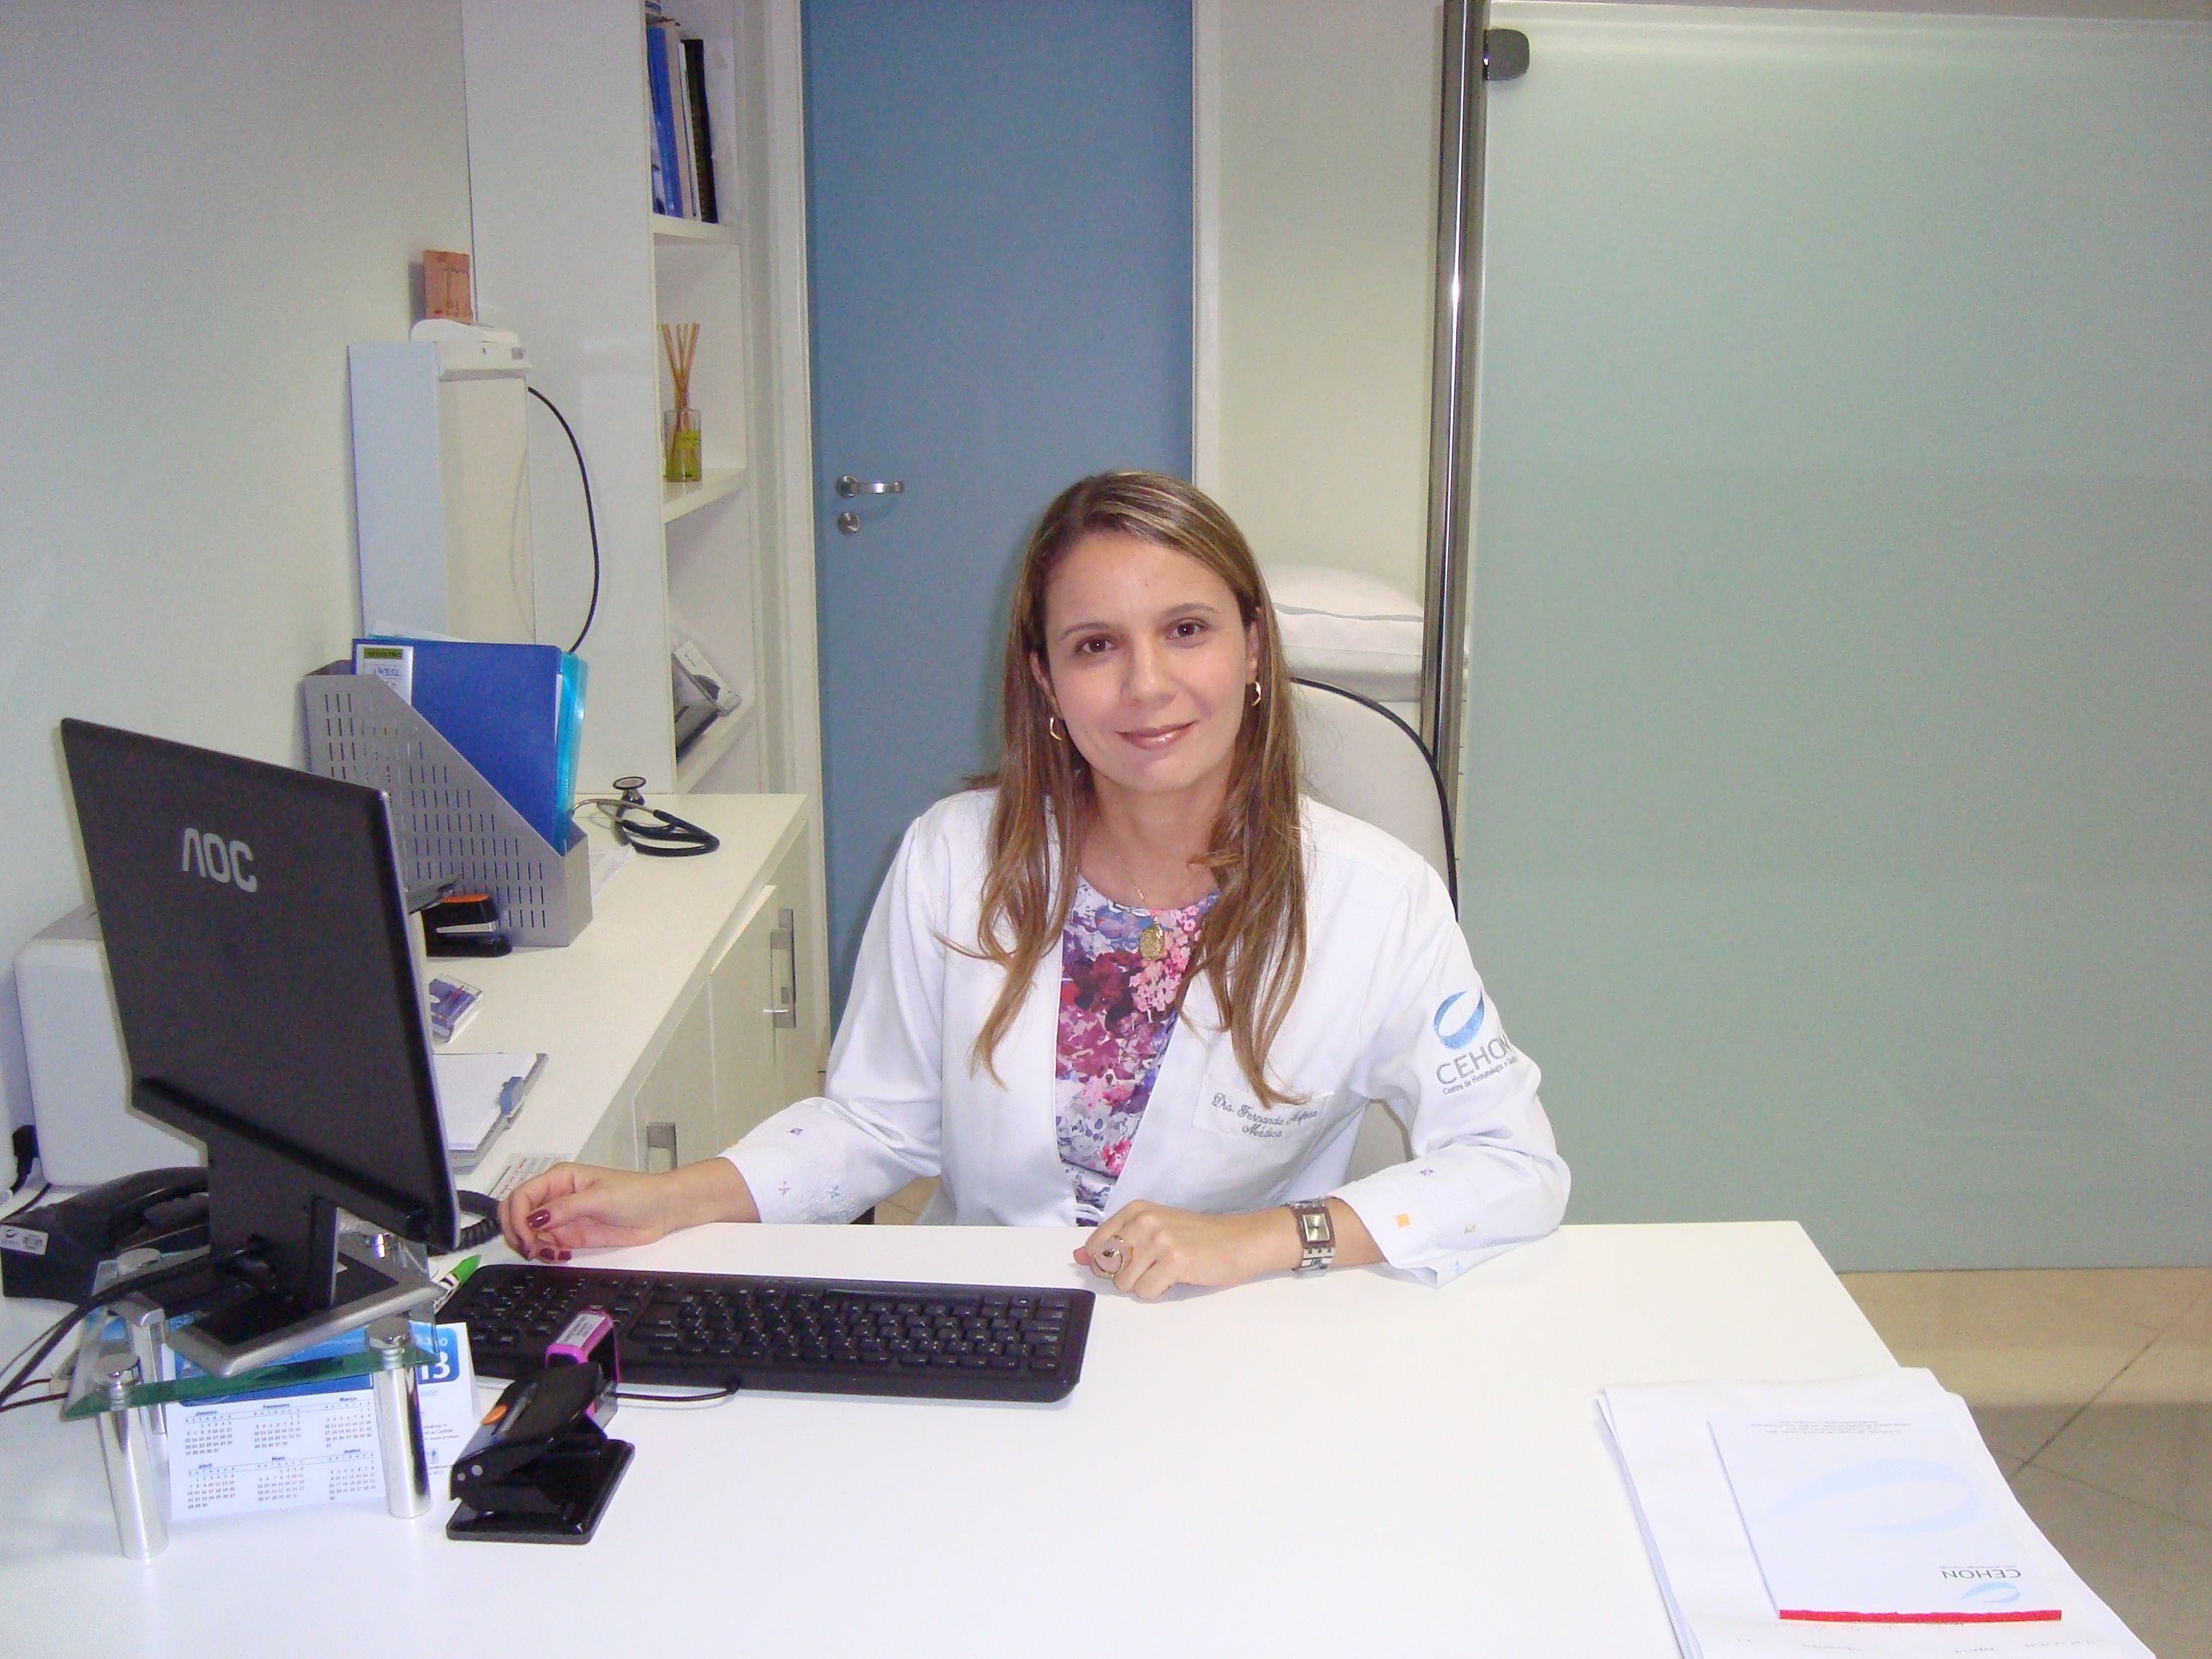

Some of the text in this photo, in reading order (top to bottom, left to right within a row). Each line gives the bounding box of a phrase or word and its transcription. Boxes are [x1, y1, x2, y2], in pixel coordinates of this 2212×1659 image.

[183, 828, 257, 892] AOC
[1437, 1034, 1513, 1085] CEHON
[1211, 1092, 1234, 1112] Dra.
[1237, 1104, 1285, 1125] Fernanda
[1941, 1568, 2021, 1579] CEHON
